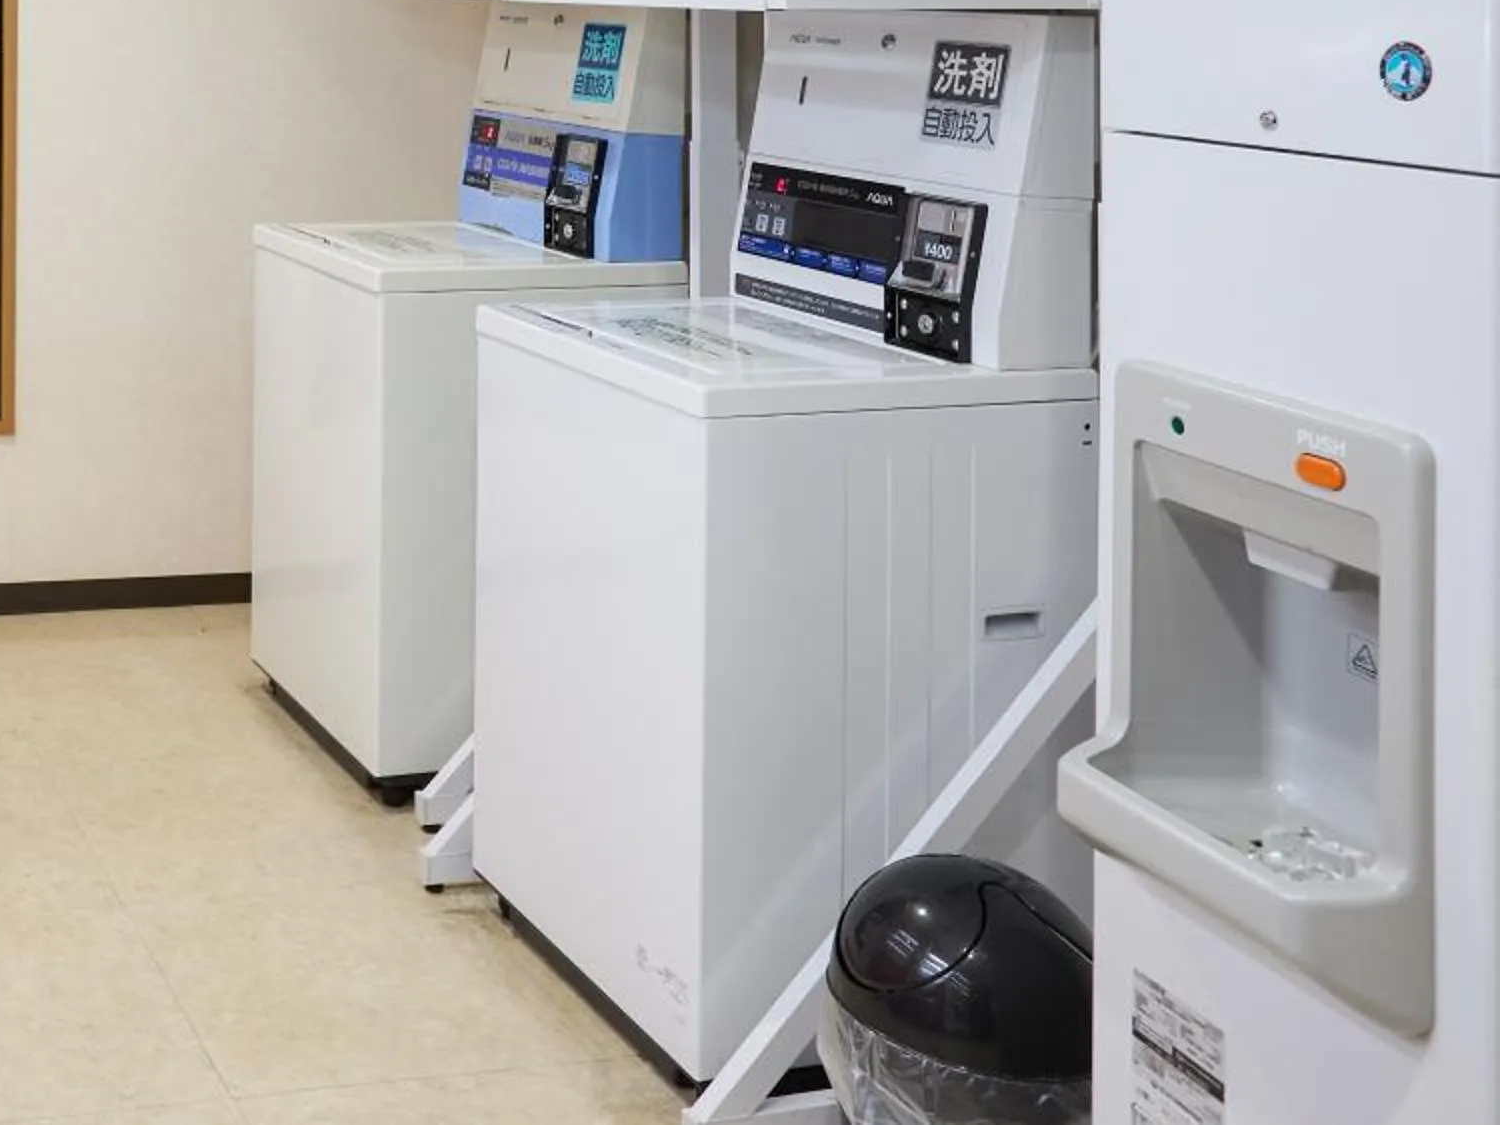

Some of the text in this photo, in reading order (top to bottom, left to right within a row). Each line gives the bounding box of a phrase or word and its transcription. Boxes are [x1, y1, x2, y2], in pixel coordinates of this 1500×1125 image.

[933, 50, 1005, 100] 洗剤
[922, 106, 995, 146] 自動投入
[1296, 428, 1348, 458] PUSH
